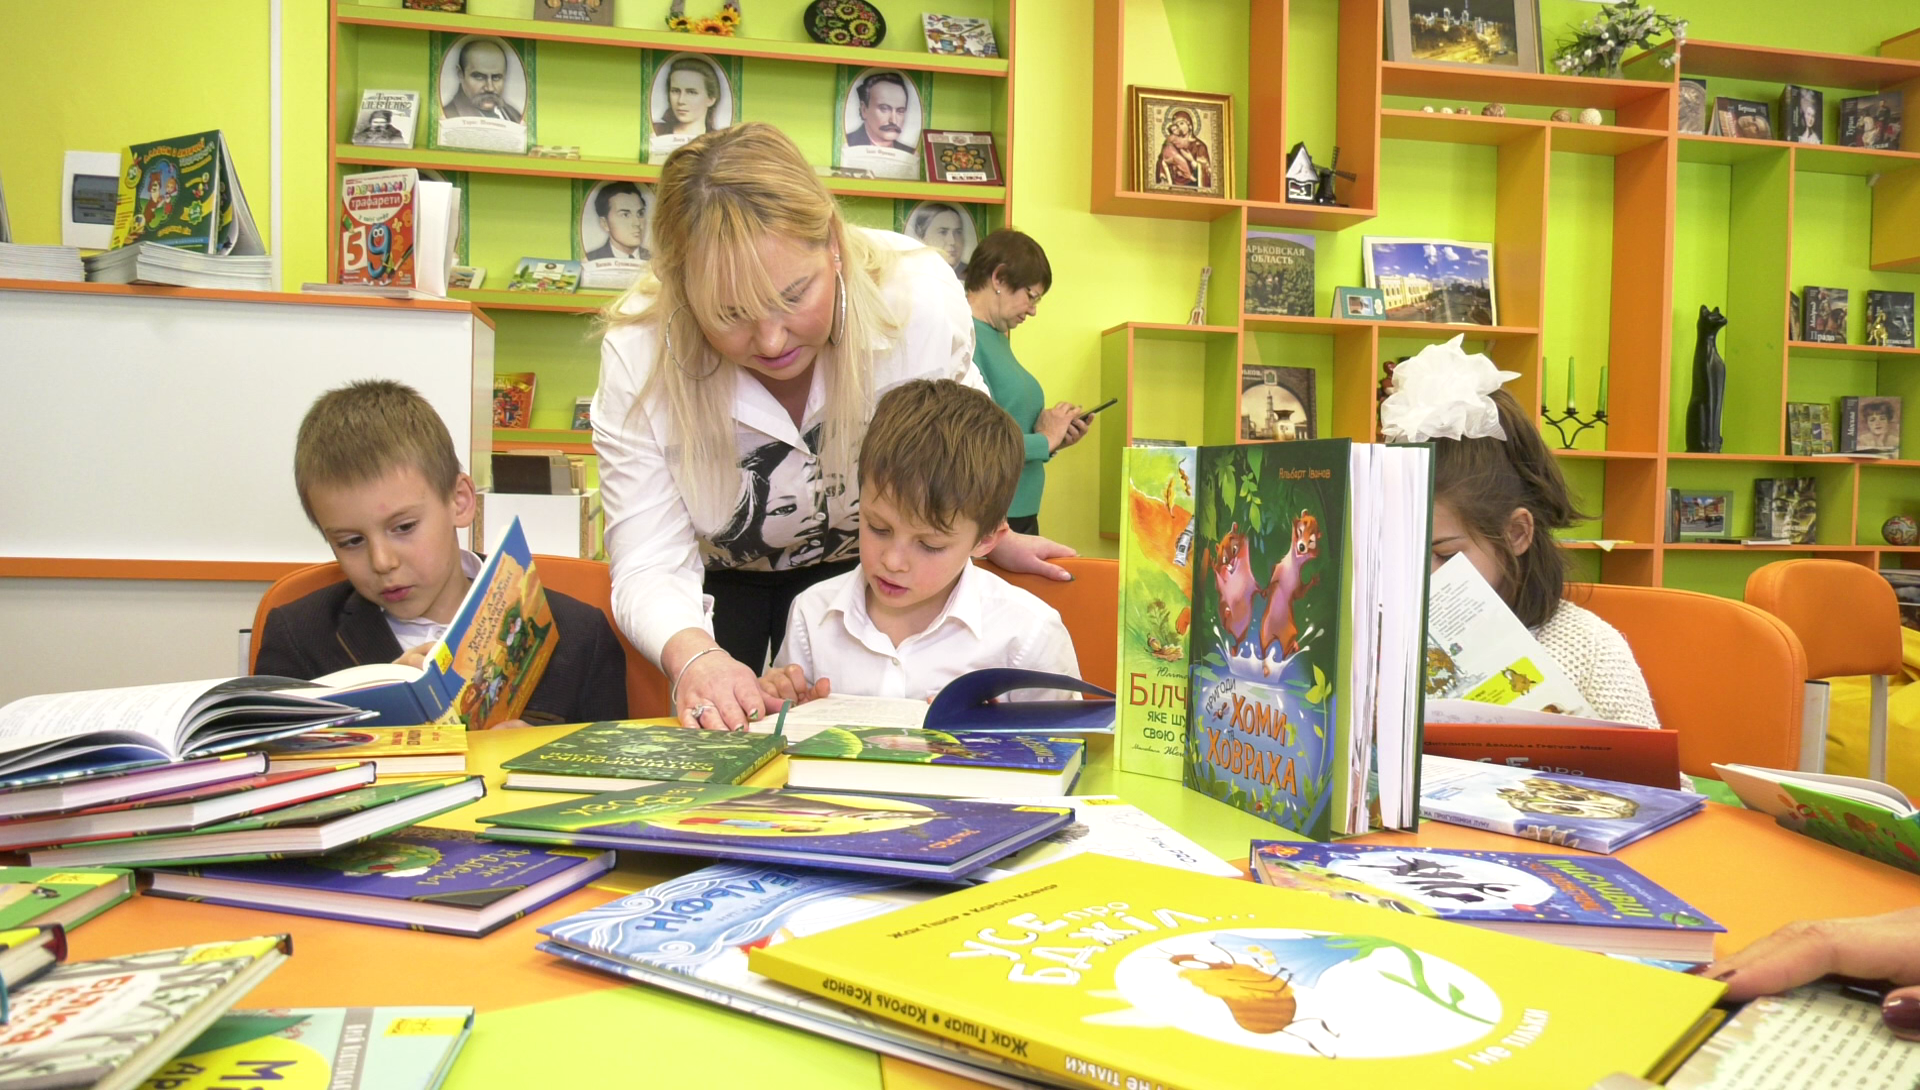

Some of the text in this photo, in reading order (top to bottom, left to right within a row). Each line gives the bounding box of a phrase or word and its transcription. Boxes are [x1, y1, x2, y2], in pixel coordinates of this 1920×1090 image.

[351, 196, 401, 211] трафарети
[1246, 244, 1305, 257] АРЬКОВСКАЯ
[1251, 253, 1294, 265] ОБЛАСТЬ
[1810, 330, 1835, 343] Прадо
[1129, 672, 1188, 711] БІЛЧ
[1205, 678, 1237, 715] ПРИГОДИ
[1143, 727, 1175, 742] СВОЮ
[1147, 711, 1186, 728] ЯКЕ ШУ
[1229, 692, 1289, 747] ХОМИ
[1205, 726, 1298, 798] ХОВРАХА
[970, 897, 1017, 914] Кароль
[1016, 883, 1059, 899] Ксенар
[947, 912, 1070, 962] УСЕ
[822, 977, 1029, 1058] Жак Гішар Кароль Ксенар
